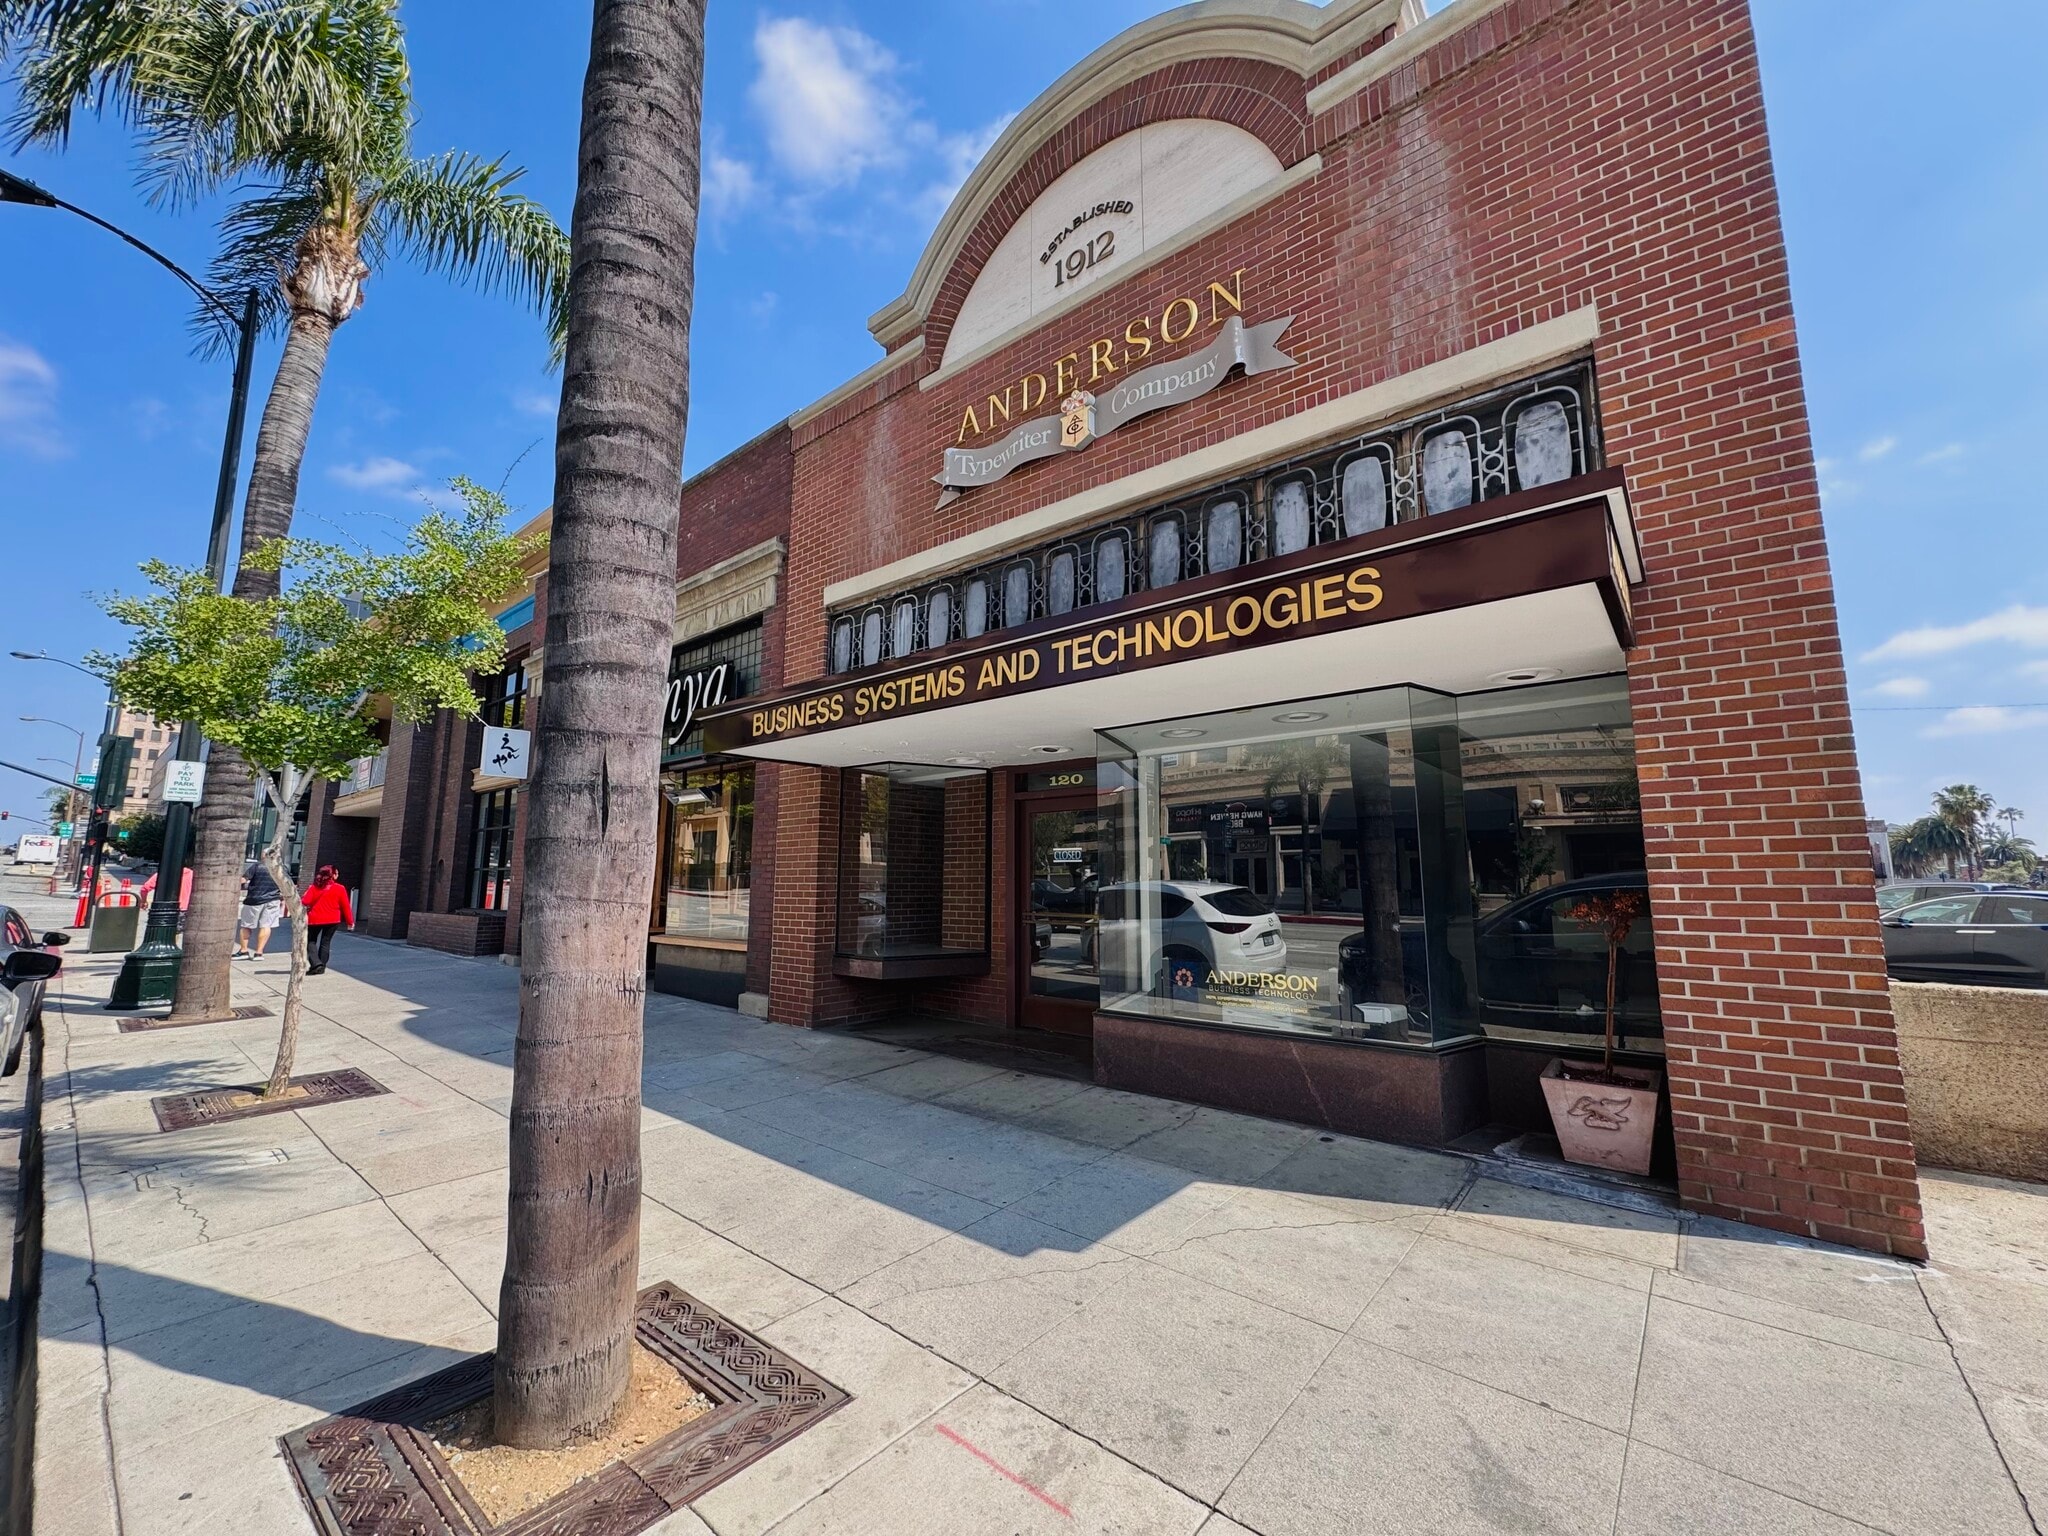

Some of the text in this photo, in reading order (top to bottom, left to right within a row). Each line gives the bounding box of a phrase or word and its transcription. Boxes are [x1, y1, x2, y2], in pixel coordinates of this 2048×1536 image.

[1040, 200, 1134, 265] ESTABLISHED
[1054, 230, 1115, 288] 1912
[956, 268, 1247, 446] ANDERSON
[953, 353, 1220, 478] Typewriter Company
[752, 567, 1384, 738] BUSINESS SYSTEMS AND TECHNOLOGIES
[662, 663, 728, 746] nya
[1049, 773, 1084, 787] 120
[24, 839, 55, 847] FedEx
[1053, 850, 1082, 861] CLOSED
[1205, 969, 1319, 993] ANDERSON
[1208, 984, 1316, 1001] BUSINESS TECHNOLOGY
